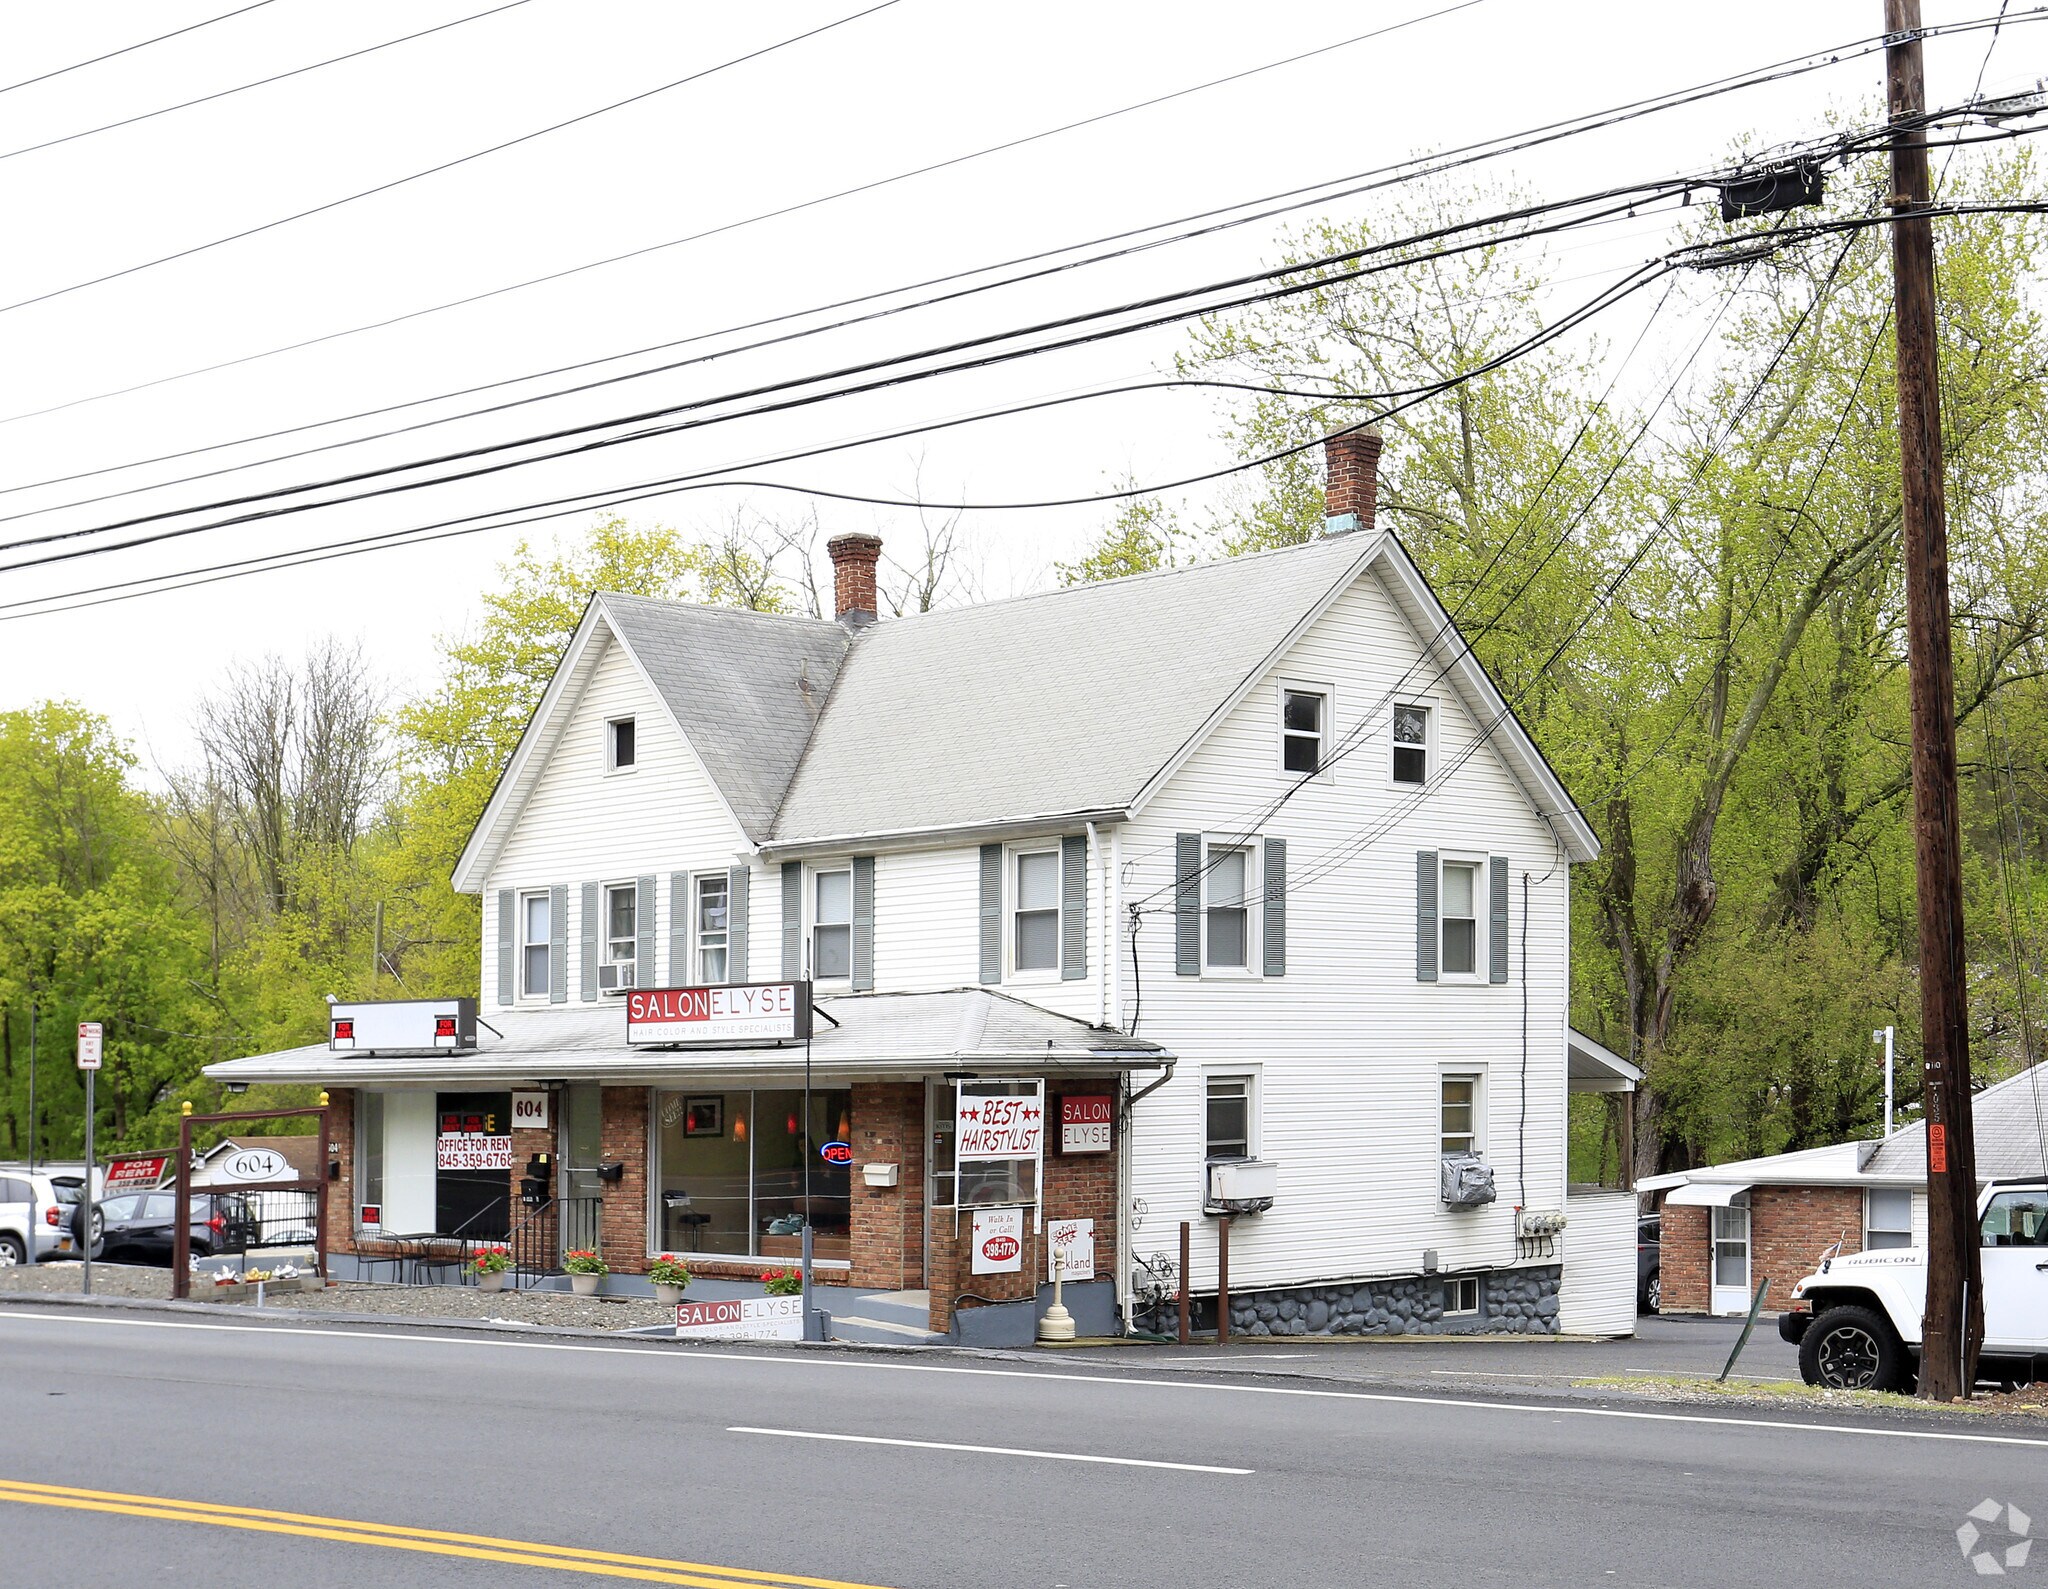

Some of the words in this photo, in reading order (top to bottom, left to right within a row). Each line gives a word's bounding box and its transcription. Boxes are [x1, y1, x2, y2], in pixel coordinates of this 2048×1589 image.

[631, 992, 708, 1019] SALON
[712, 987, 791, 1014] ELYSE
[633, 1028, 653, 1037] HAIR
[657, 1027, 686, 1036] COLOR
[690, 1026, 708, 1035] AND
[712, 1025, 735, 1034] STYLE
[739, 1023, 792, 1034] SPECIALISTS
[516, 1100, 542, 1118] 604
[982, 1100, 1023, 1125] BEST
[1063, 1103, 1111, 1121] SALON
[959, 1128, 1040, 1152] HAIRSTYLIST
[1064, 1126, 1110, 1144] ELYSE
[438, 1138, 468, 1152] OFFICE
[470, 1138, 488, 1152] FOR
[438, 1152, 512, 1167] 845-359-6768
[823, 1147, 853, 1160] OPEN
[123, 1160, 153, 1169] FOR
[236, 1155, 273, 1173] 604
[114, 1167, 156, 1179] RENT
[988, 1215, 1004, 1223] Walk
[1006, 1215, 1014, 1223] In
[1051, 1222, 1078, 1241] COME
[985, 1242, 1016, 1258] 398-1774
[1848, 1257, 1916, 1265] RUBICON
[678, 1304, 740, 1324] SALON
[743, 1300, 801, 1318] ELYSE
[763, 1319, 800, 1327] SPECIALISTS
